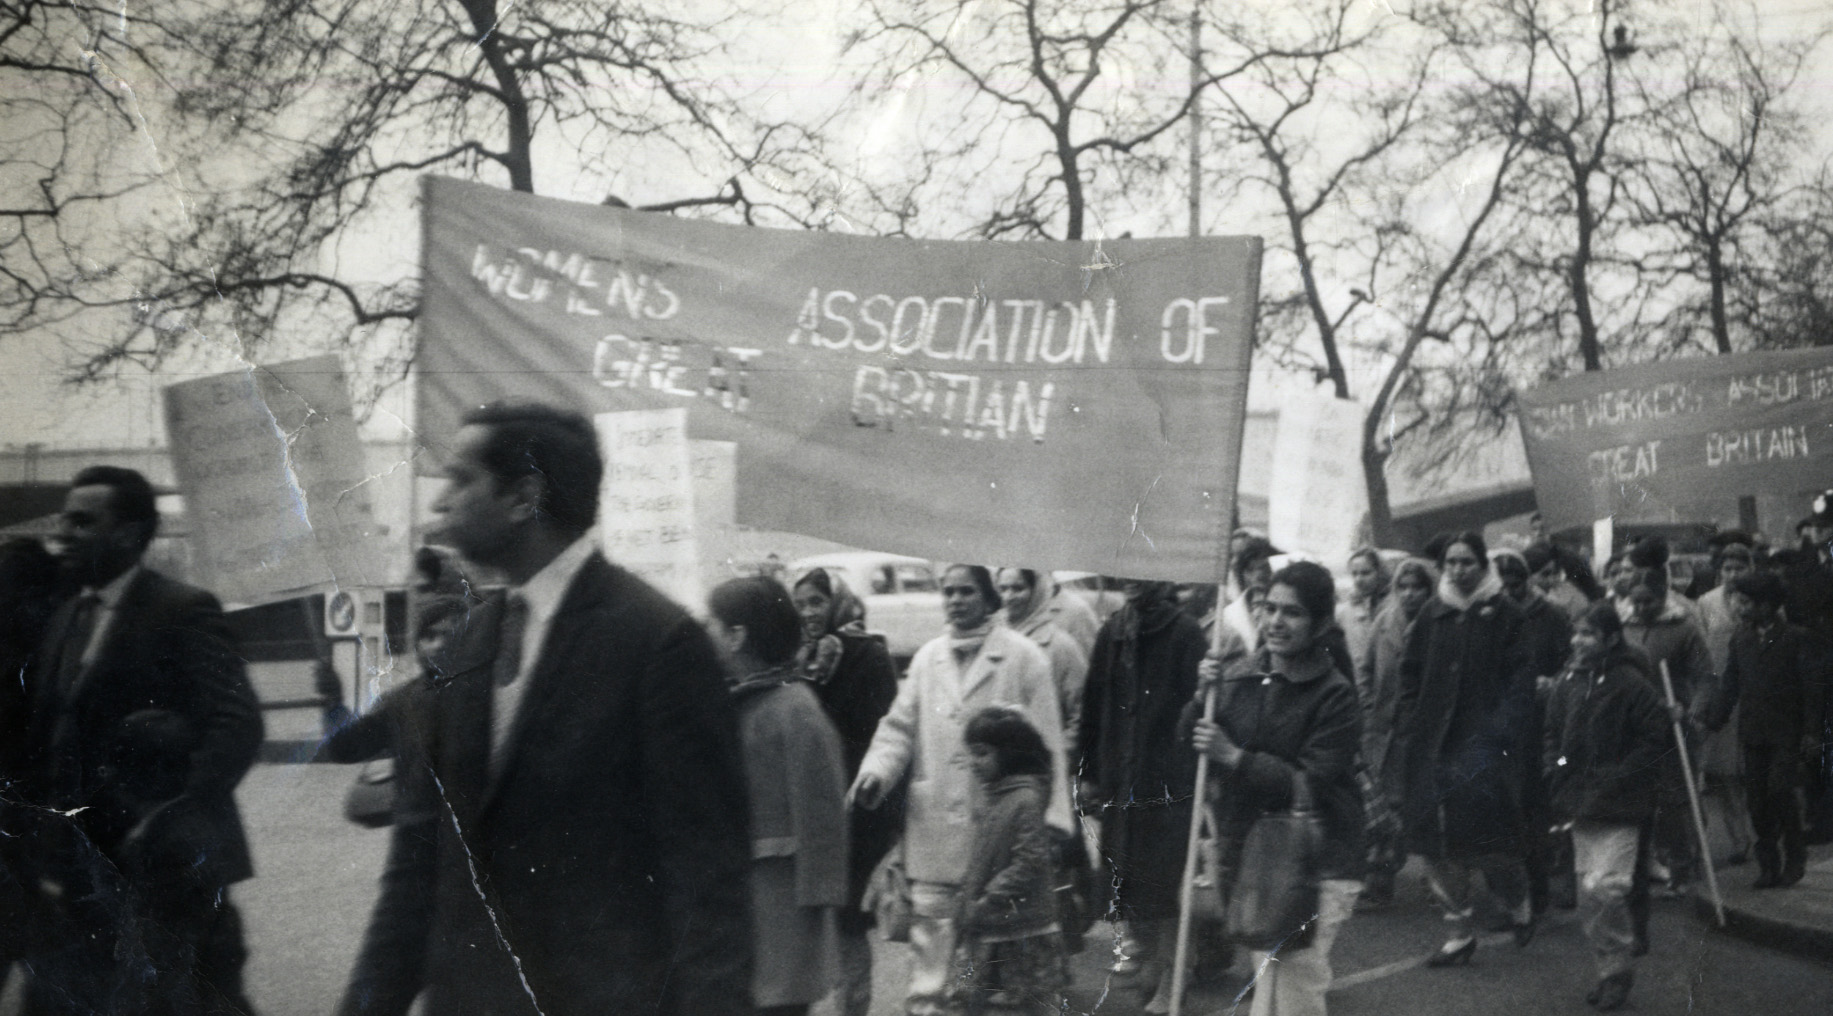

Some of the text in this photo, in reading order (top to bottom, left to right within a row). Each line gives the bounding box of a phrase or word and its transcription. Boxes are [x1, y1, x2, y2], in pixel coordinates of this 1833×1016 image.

[787, 287, 1116, 364] ASSOCIATION
[1159, 296, 1230, 365] OF
[593, 334, 763, 412] GREAT
[1705, 425, 1809, 467] BRITAIN
